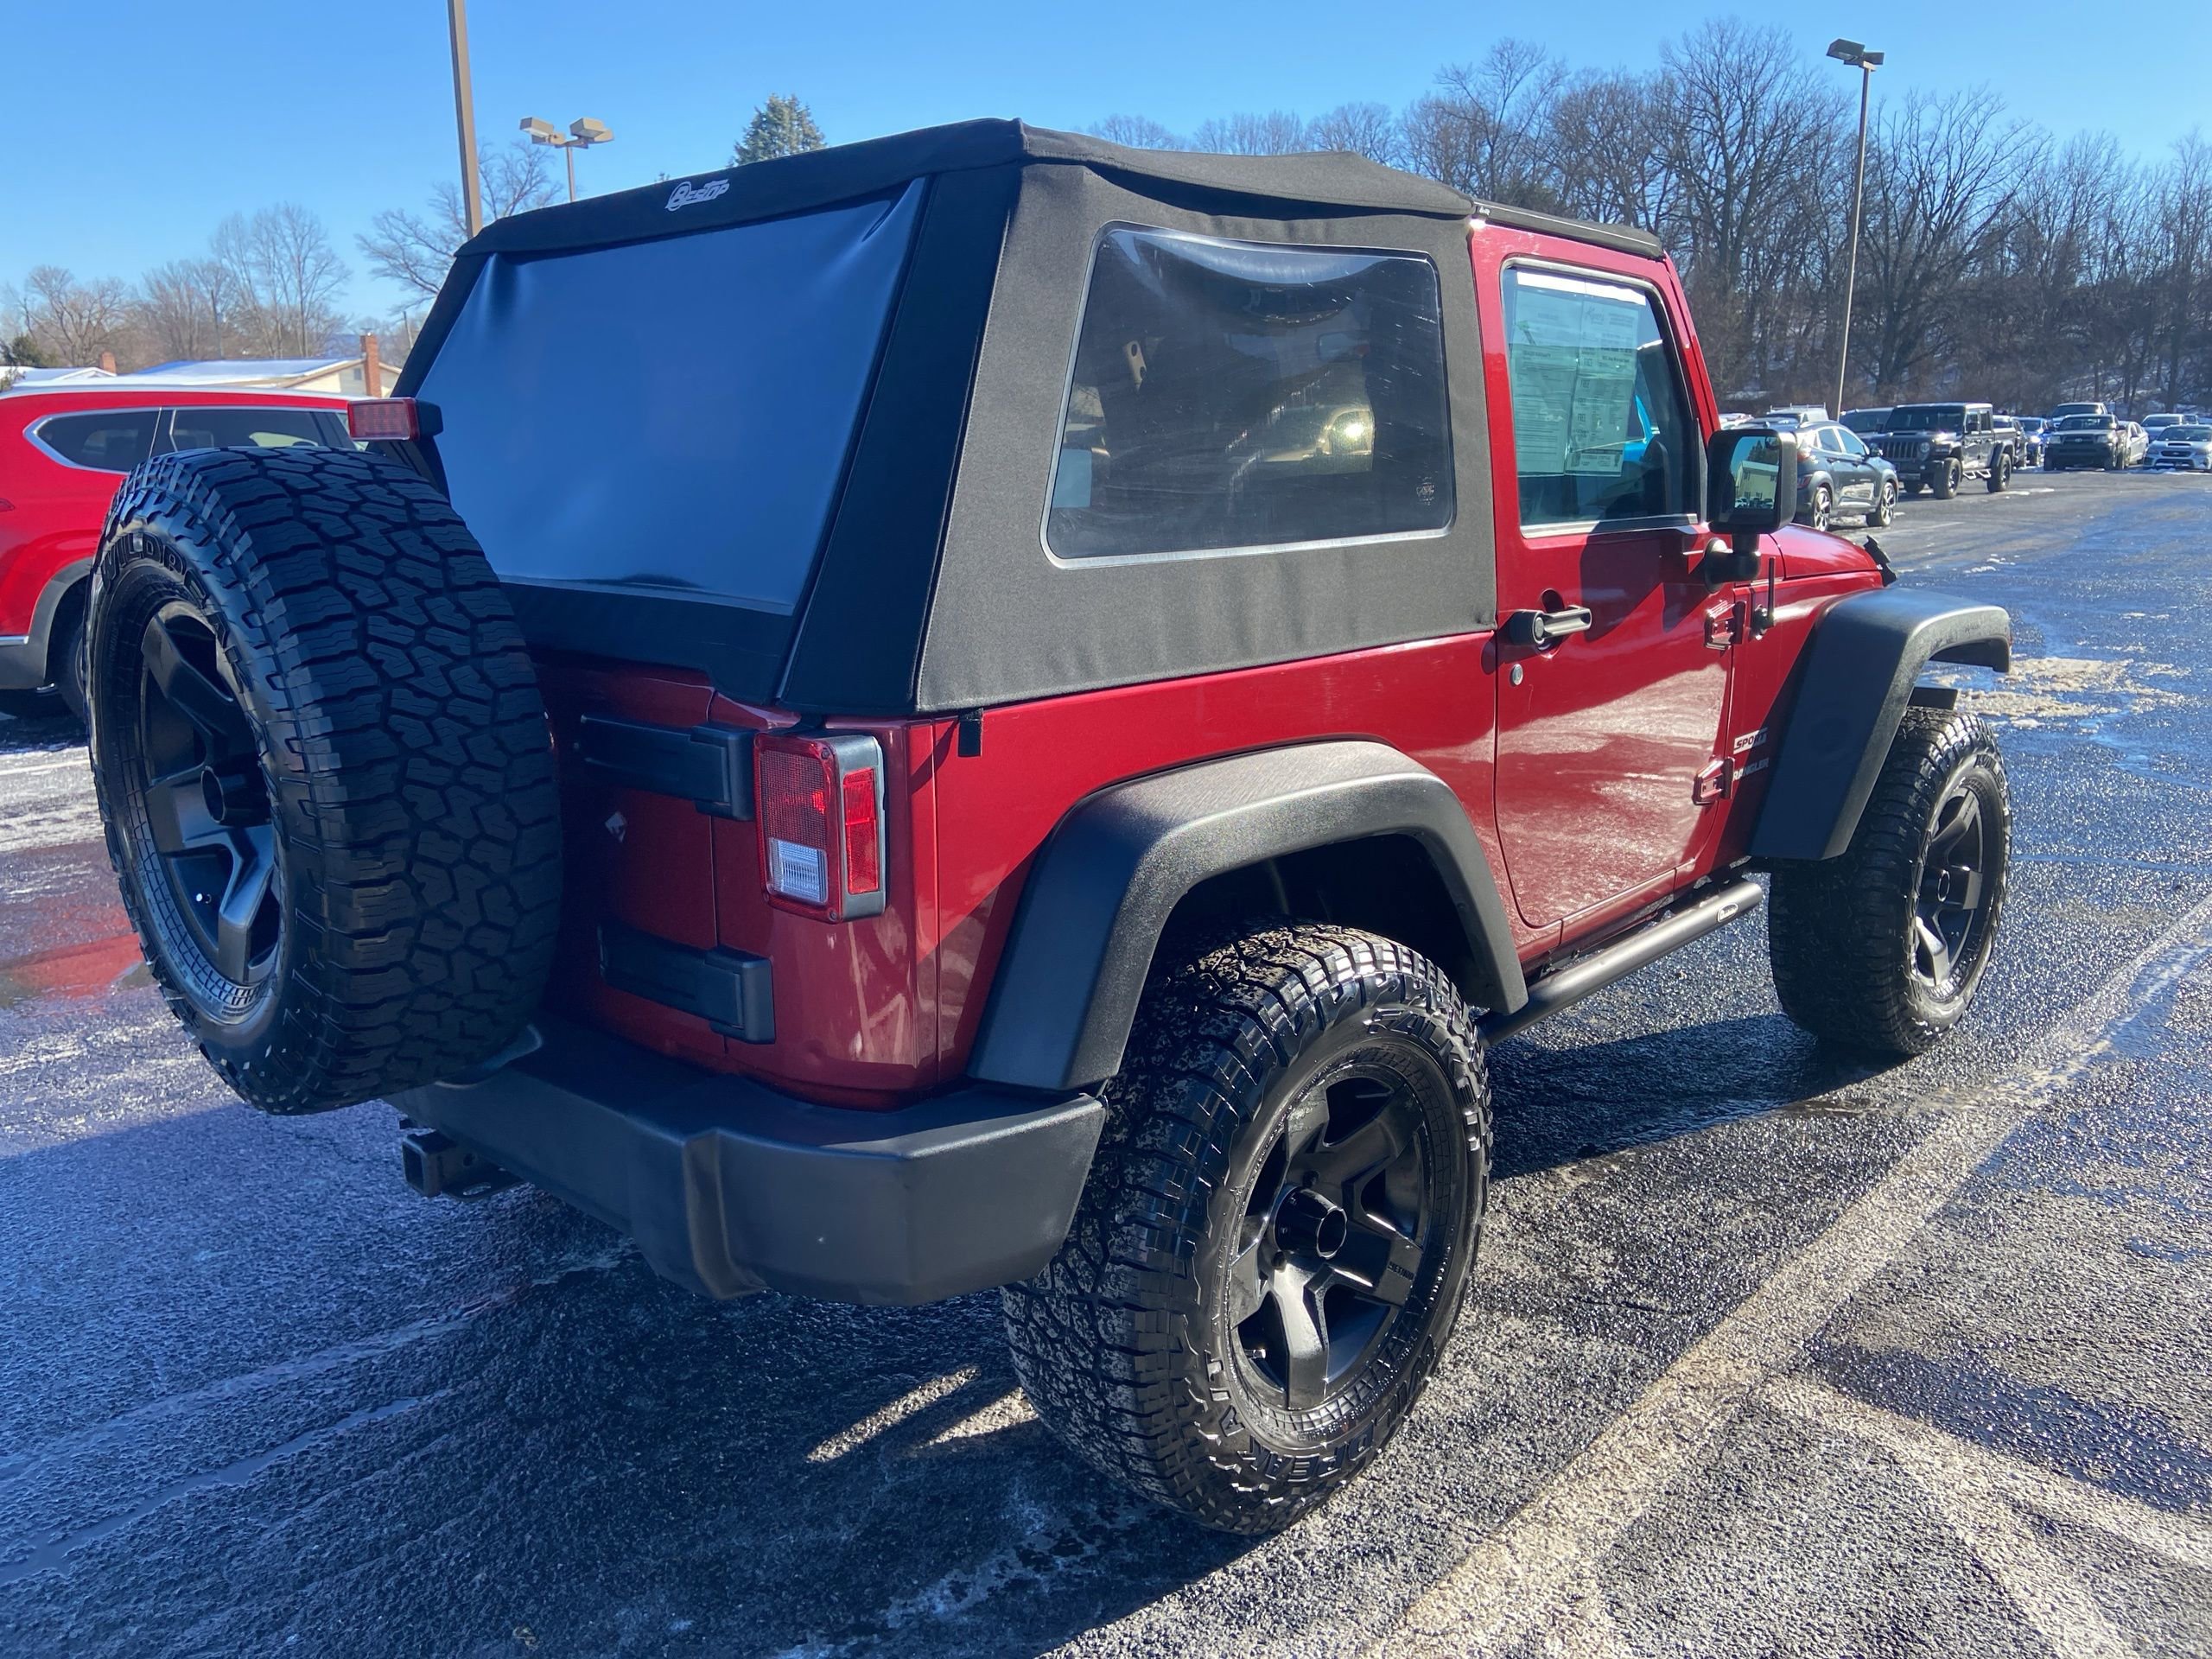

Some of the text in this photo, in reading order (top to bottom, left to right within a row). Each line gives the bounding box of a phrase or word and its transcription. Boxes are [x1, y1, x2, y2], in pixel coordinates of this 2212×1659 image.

[1733, 728, 1768, 752] SPORT
[1733, 758, 1770, 781] RANGLER
[1363, 1007, 1482, 1152] FALKEN
[1236, 1335, 1437, 1483] WILDPEAK
